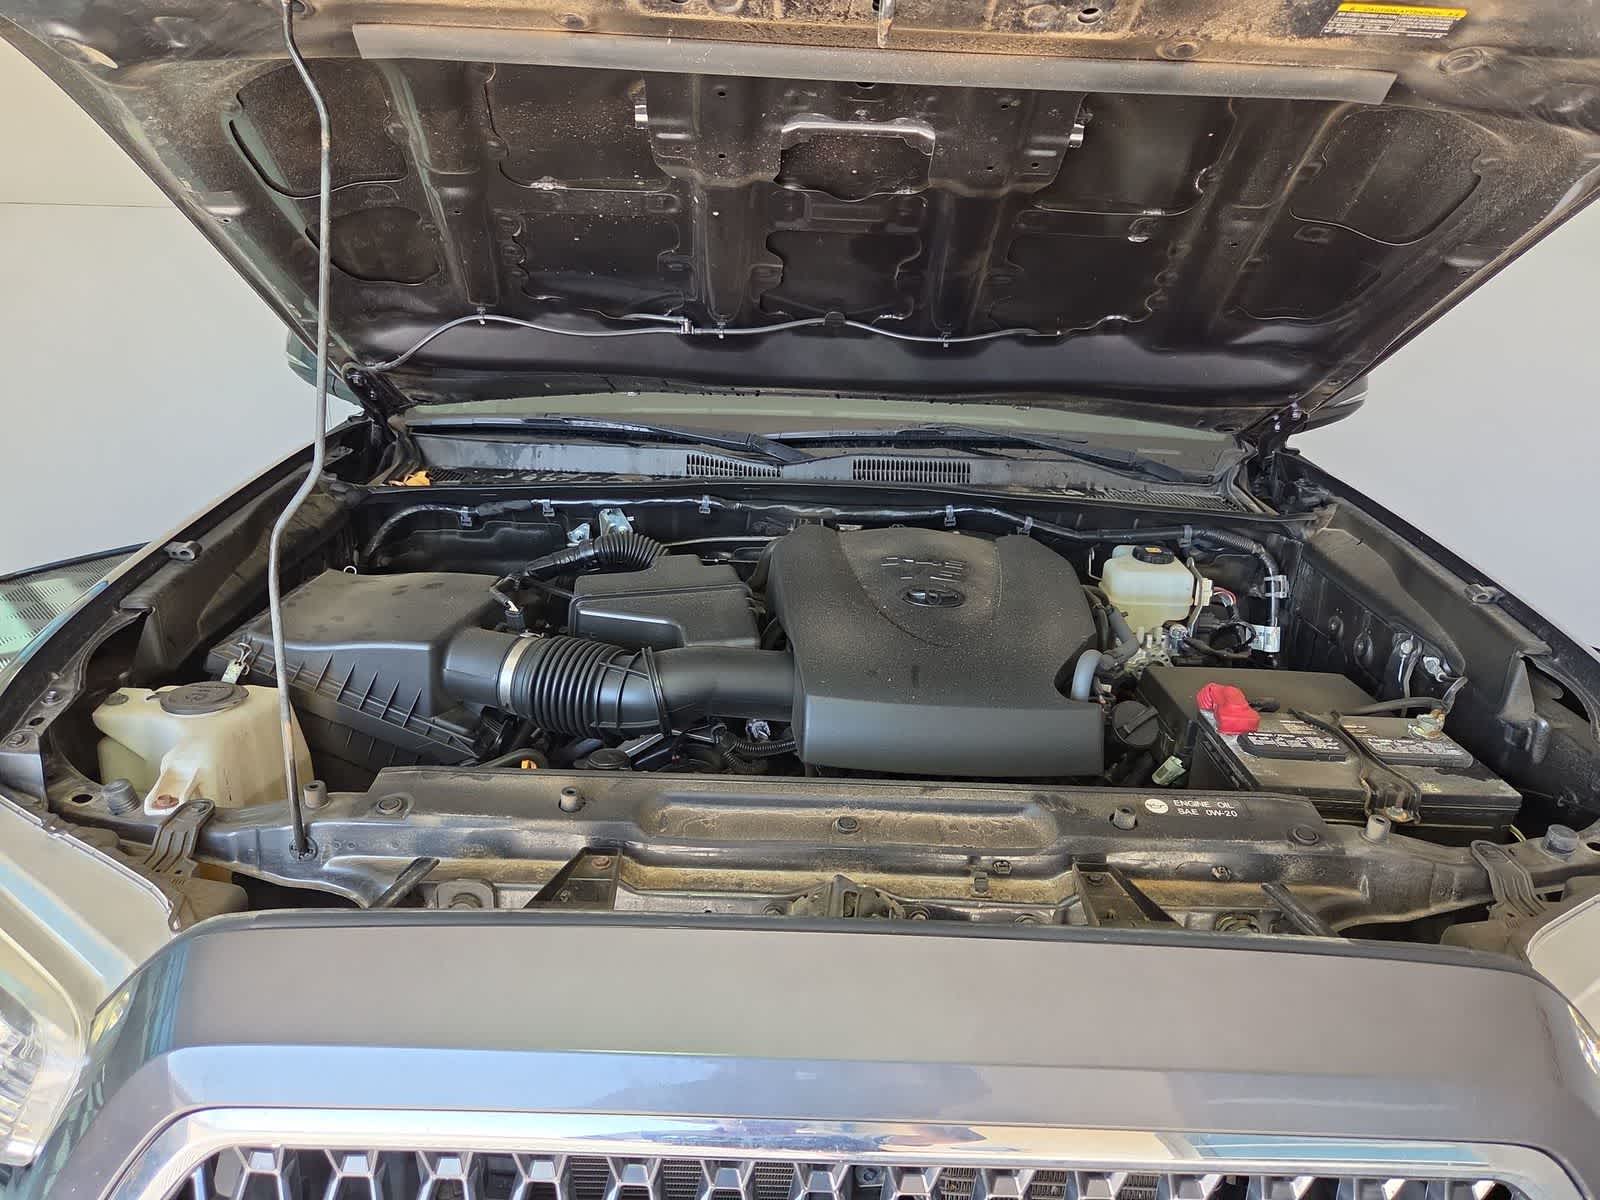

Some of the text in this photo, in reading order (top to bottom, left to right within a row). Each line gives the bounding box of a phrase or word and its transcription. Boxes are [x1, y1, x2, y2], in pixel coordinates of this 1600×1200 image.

[1173, 799, 1234, 809] ENGINE OIL
[1178, 808, 1238, 817] SAE 0W-20
